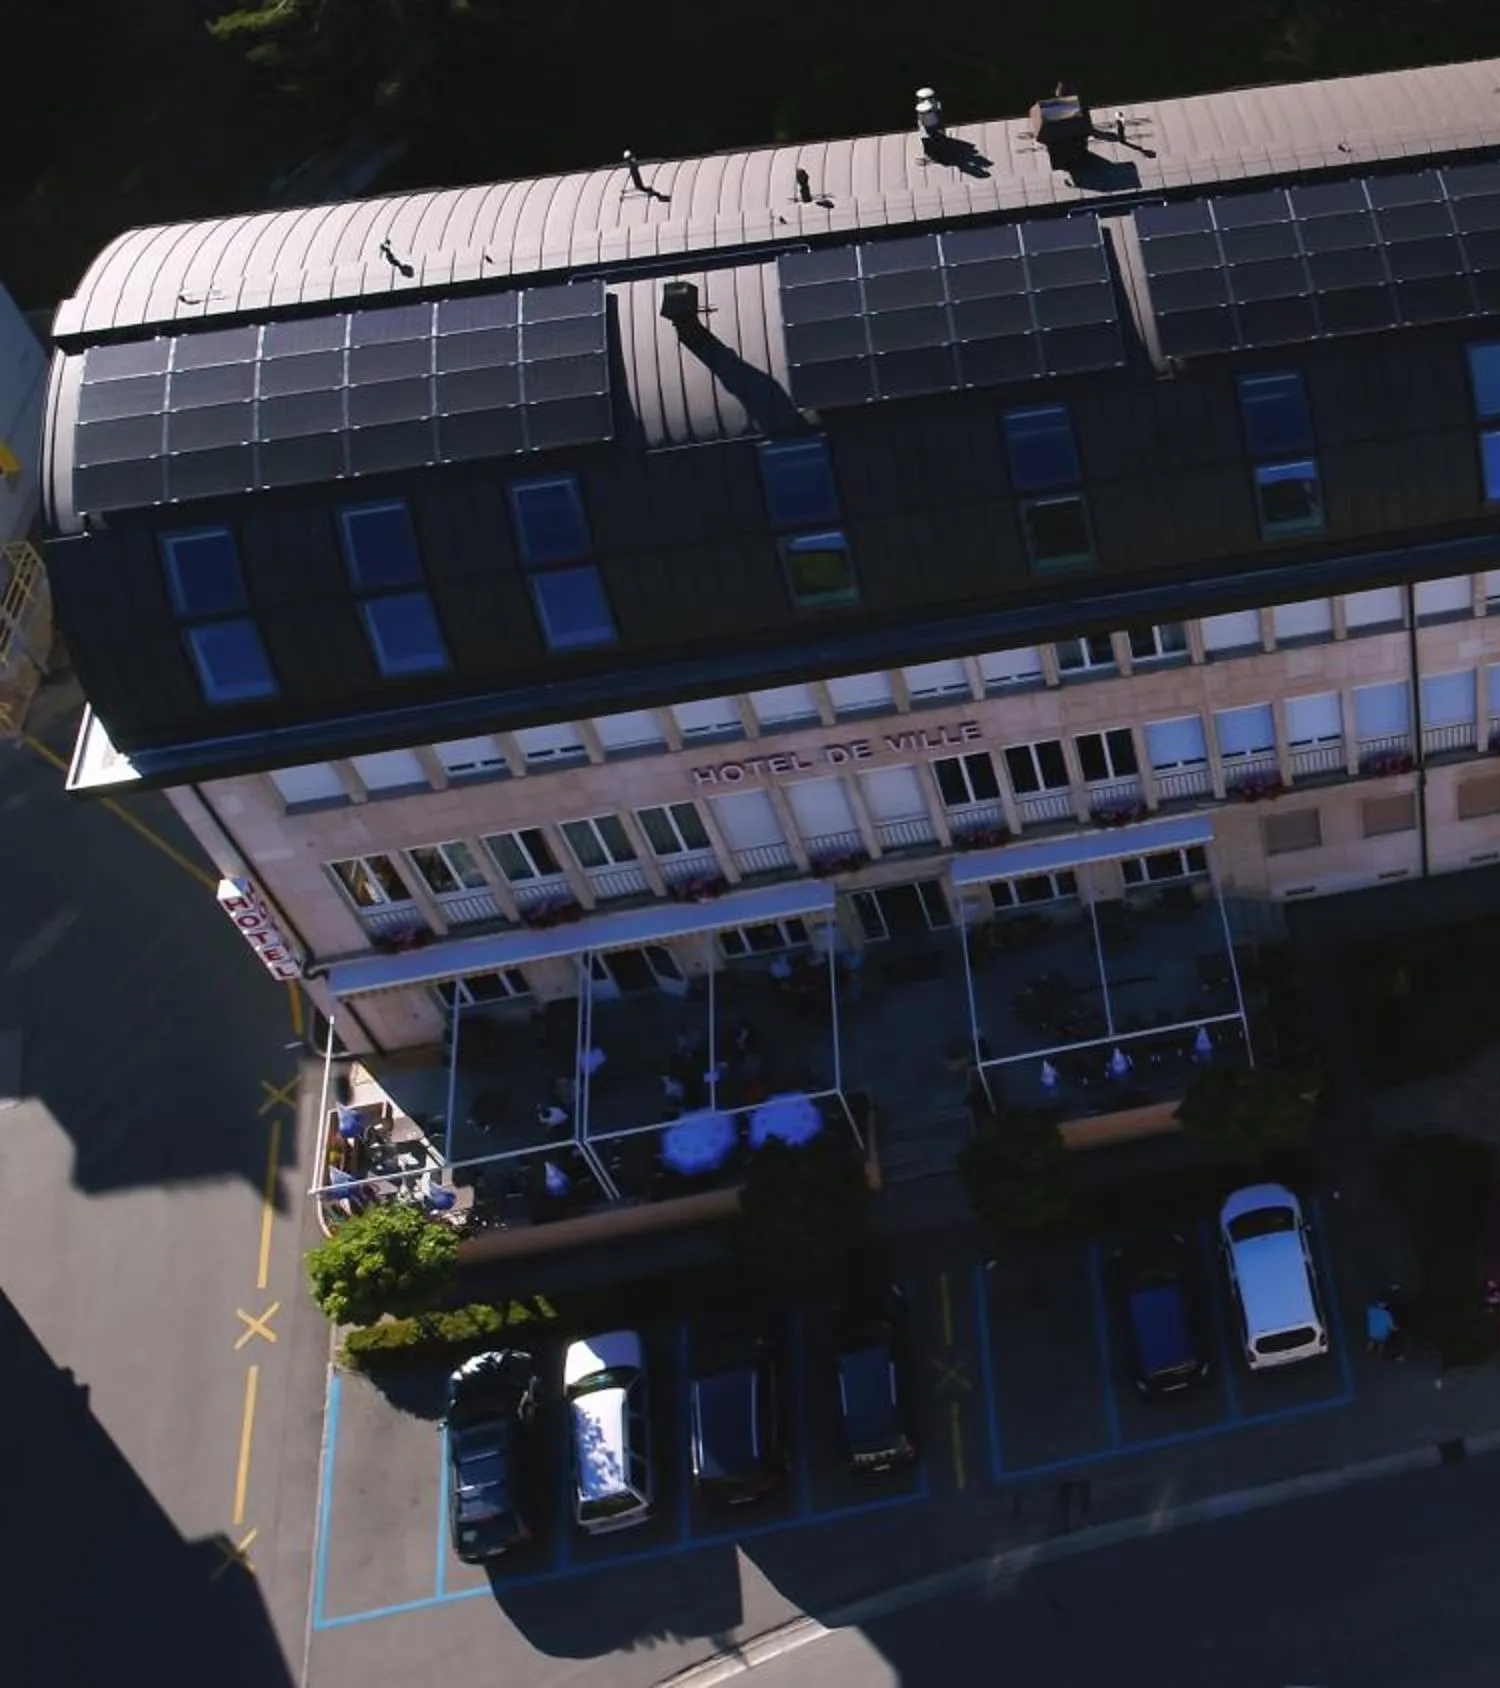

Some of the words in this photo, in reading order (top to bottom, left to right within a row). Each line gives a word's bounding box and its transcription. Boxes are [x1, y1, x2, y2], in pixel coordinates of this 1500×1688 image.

[691, 752, 813, 785] HOTEL
[823, 739, 873, 766] DE
[883, 720, 982, 753] VILLE
[223, 899, 295, 977] HOTEL
